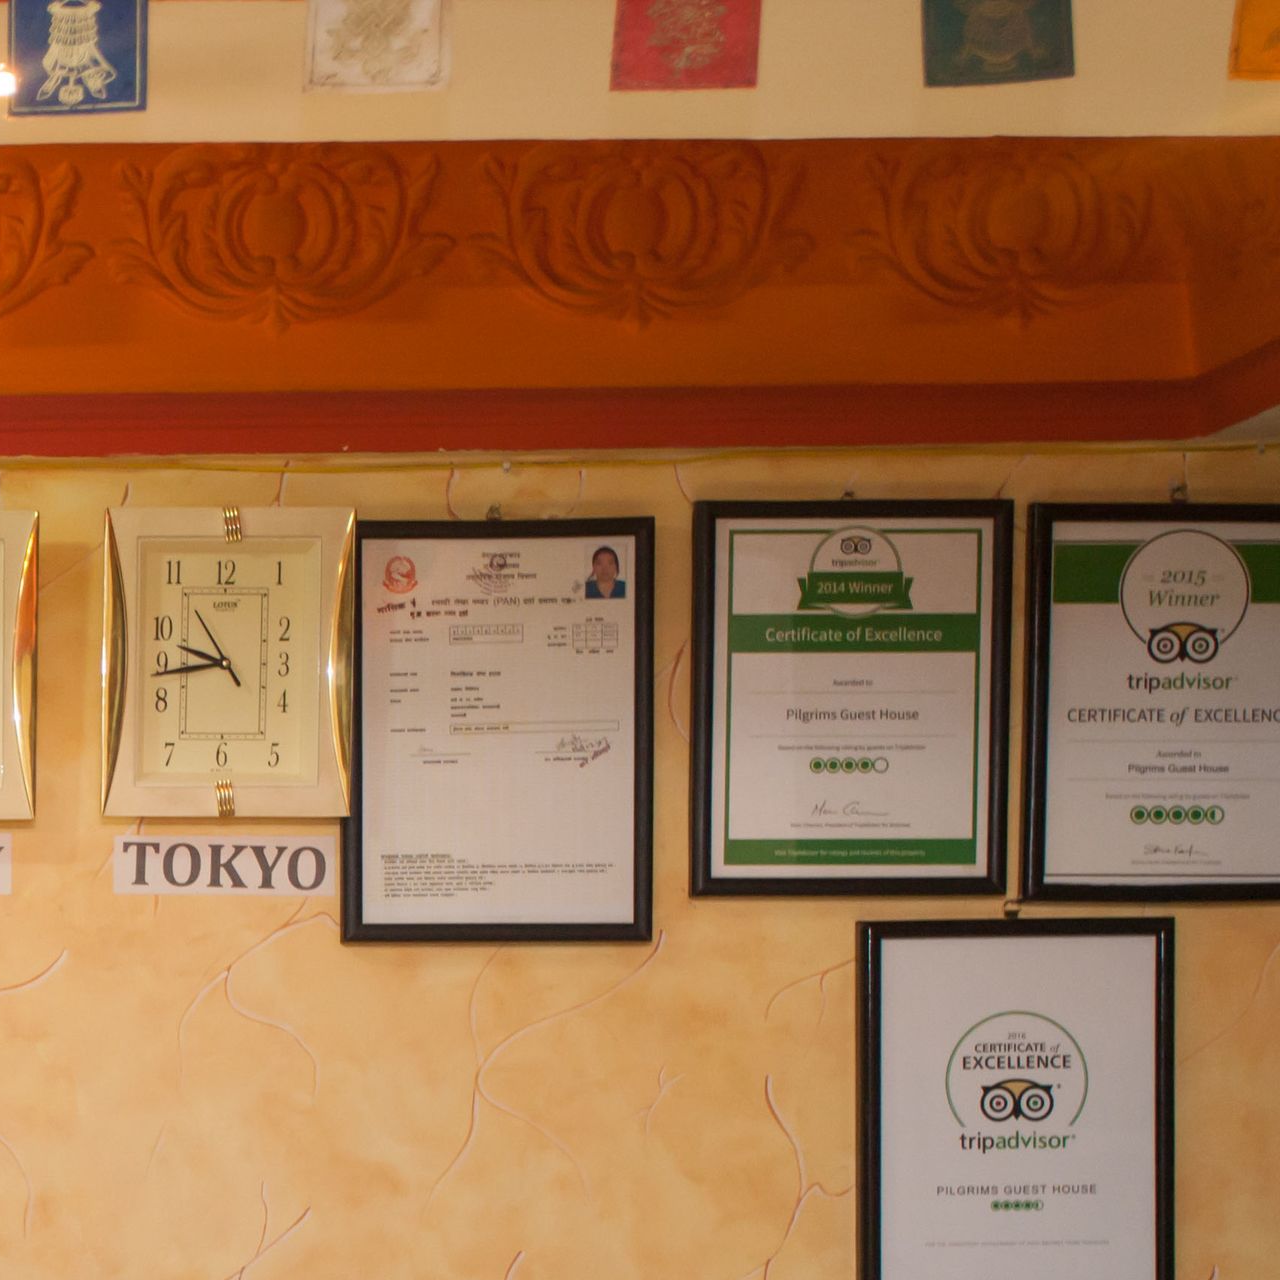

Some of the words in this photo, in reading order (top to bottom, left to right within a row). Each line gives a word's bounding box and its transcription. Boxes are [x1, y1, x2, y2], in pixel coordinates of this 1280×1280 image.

[167, 560, 181, 585] 11
[217, 560, 236, 585] 12
[276, 561, 283, 585] 1
[1160, 570, 1206, 585] 2015
[817, 582, 845, 594] 2014
[849, 582, 893, 594] Winner
[1148, 588, 1220, 608] Winner
[213, 601, 238, 609] LOTUS
[153, 615, 173, 641] 10
[279, 616, 290, 641] 2
[765, 626, 842, 642] Certificate
[846, 626, 862, 641] of
[865, 626, 943, 642] Excellence
[156, 651, 168, 676] 9
[278, 652, 289, 677] 3
[1127, 672, 1233, 694] tripadvisor
[155, 687, 168, 712] 8
[277, 689, 288, 713] 4
[786, 708, 837, 724] Pilgrims
[840, 708, 876, 721] Guest
[879, 708, 919, 721] House
[1067, 708, 1165, 723] CERTIFICATE
[1170, 706, 1189, 727] of
[165, 743, 175, 767] 7
[216, 742, 228, 767] 6
[268, 743, 279, 767] 5
[1127, 764, 1165, 775] Pilgrims
[1167, 764, 1196, 774] Guest
[1199, 764, 1229, 774] House
[123, 842, 326, 890] TOKYO
[974, 1043, 1046, 1053] CERTIFICATE
[1049, 1043, 1060, 1053] of
[962, 1055, 1072, 1070] EXCELLENCE
[960, 1130, 1070, 1154] tripadvisor
[937, 1185, 999, 1196] PILGRIMS
[1003, 1185, 1046, 1195] GUEST
[1052, 1184, 1097, 1194] HOUSE
